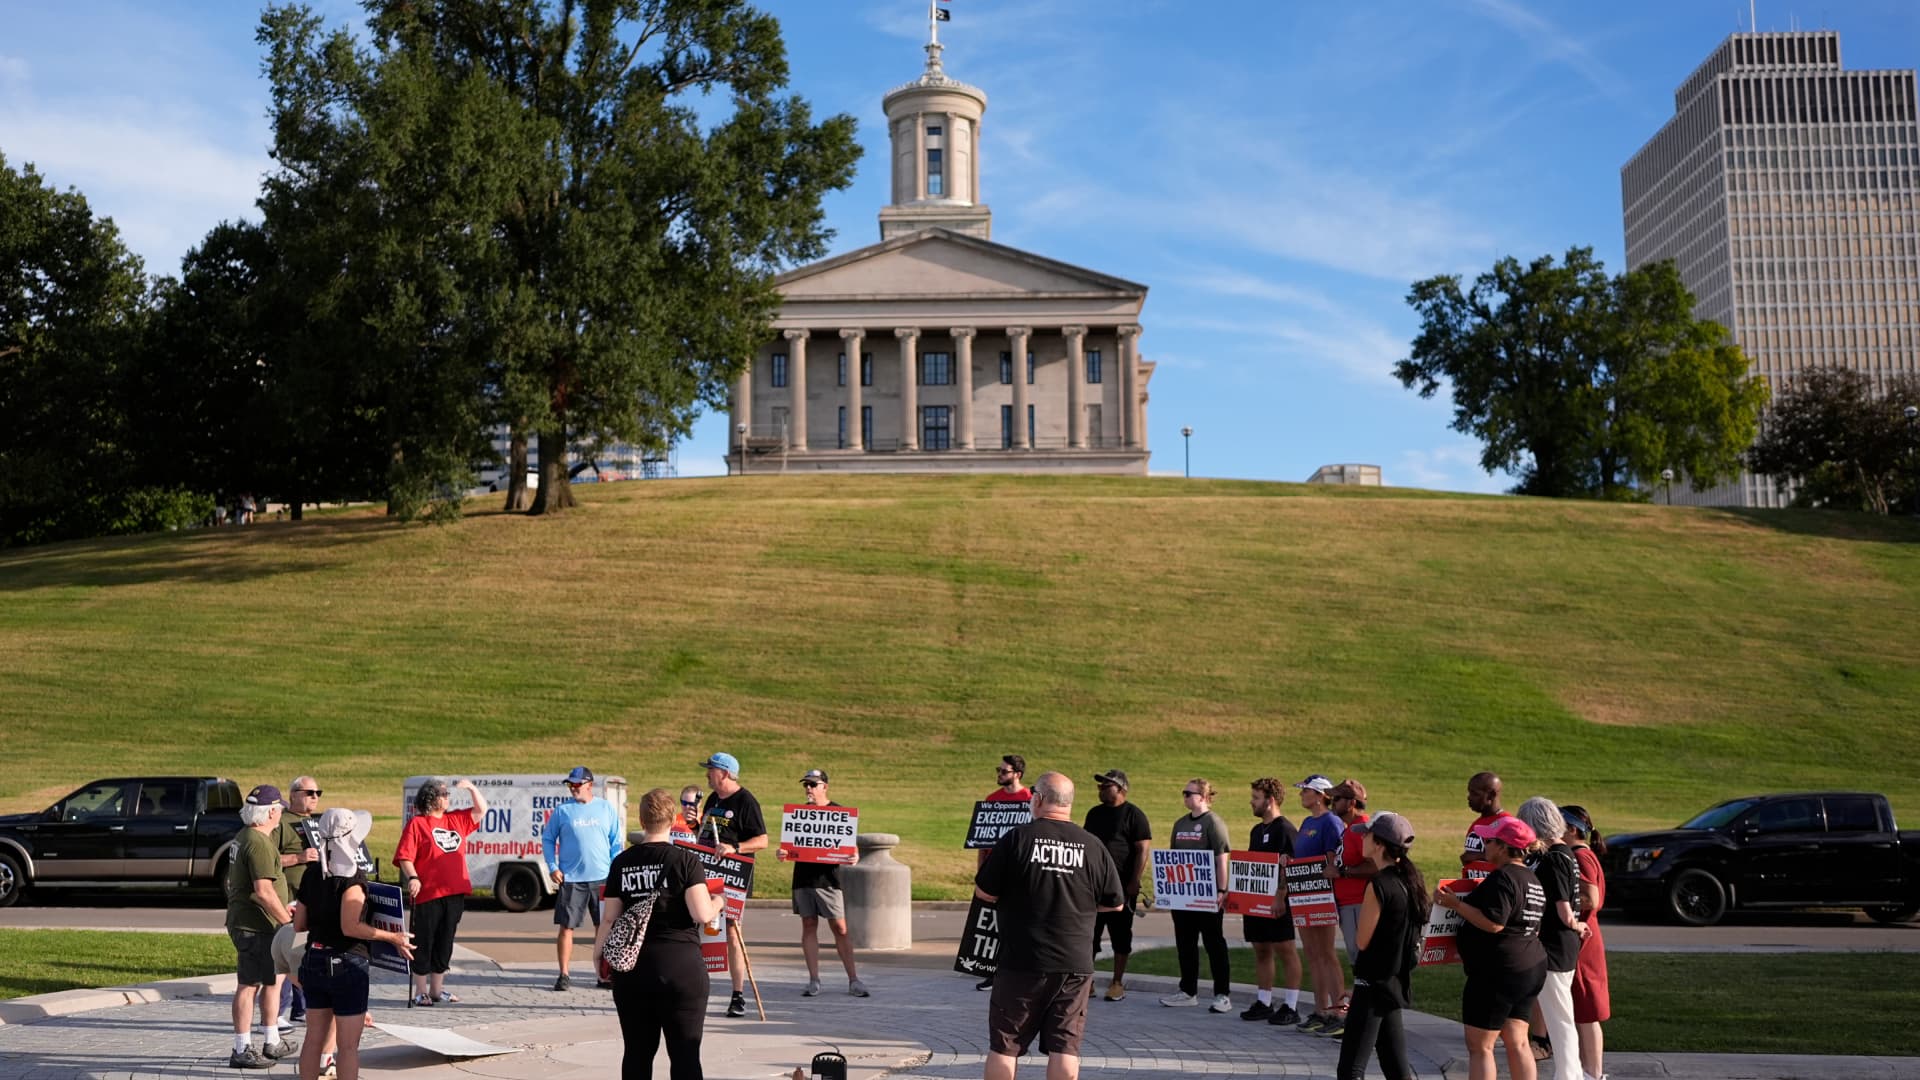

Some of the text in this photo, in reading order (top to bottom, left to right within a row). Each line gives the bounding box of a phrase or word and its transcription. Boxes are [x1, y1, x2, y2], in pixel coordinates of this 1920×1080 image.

[994, 802, 1020, 810] Oppose
[532, 811, 543, 822] IS
[791, 809, 849, 823] JUSTICE
[976, 811, 1033, 824] EXECUTION
[784, 822, 854, 836] REQUIRES
[974, 826, 998, 839] THIS
[794, 836, 842, 848] MERCY
[1056, 840, 1085, 849] PENALTY
[1030, 844, 1085, 868] ACTION
[1153, 851, 1211, 867] EXECUTION
[719, 858, 742, 872] ARE
[1231, 861, 1276, 878] THOU SHALT
[1285, 863, 1323, 877] BLESSED ARE
[703, 868, 745, 888] ERCIFUL
[1155, 863, 1212, 884] IS NOT THE
[1467, 869, 1490, 879] DEAT
[1156, 881, 1213, 897] SOLUTION
[1235, 877, 1269, 894] NOT KILL!
[1288, 879, 1331, 892] THE MERCIFUL
[1430, 923, 1444, 934] THE
[973, 934, 998, 960] TH
